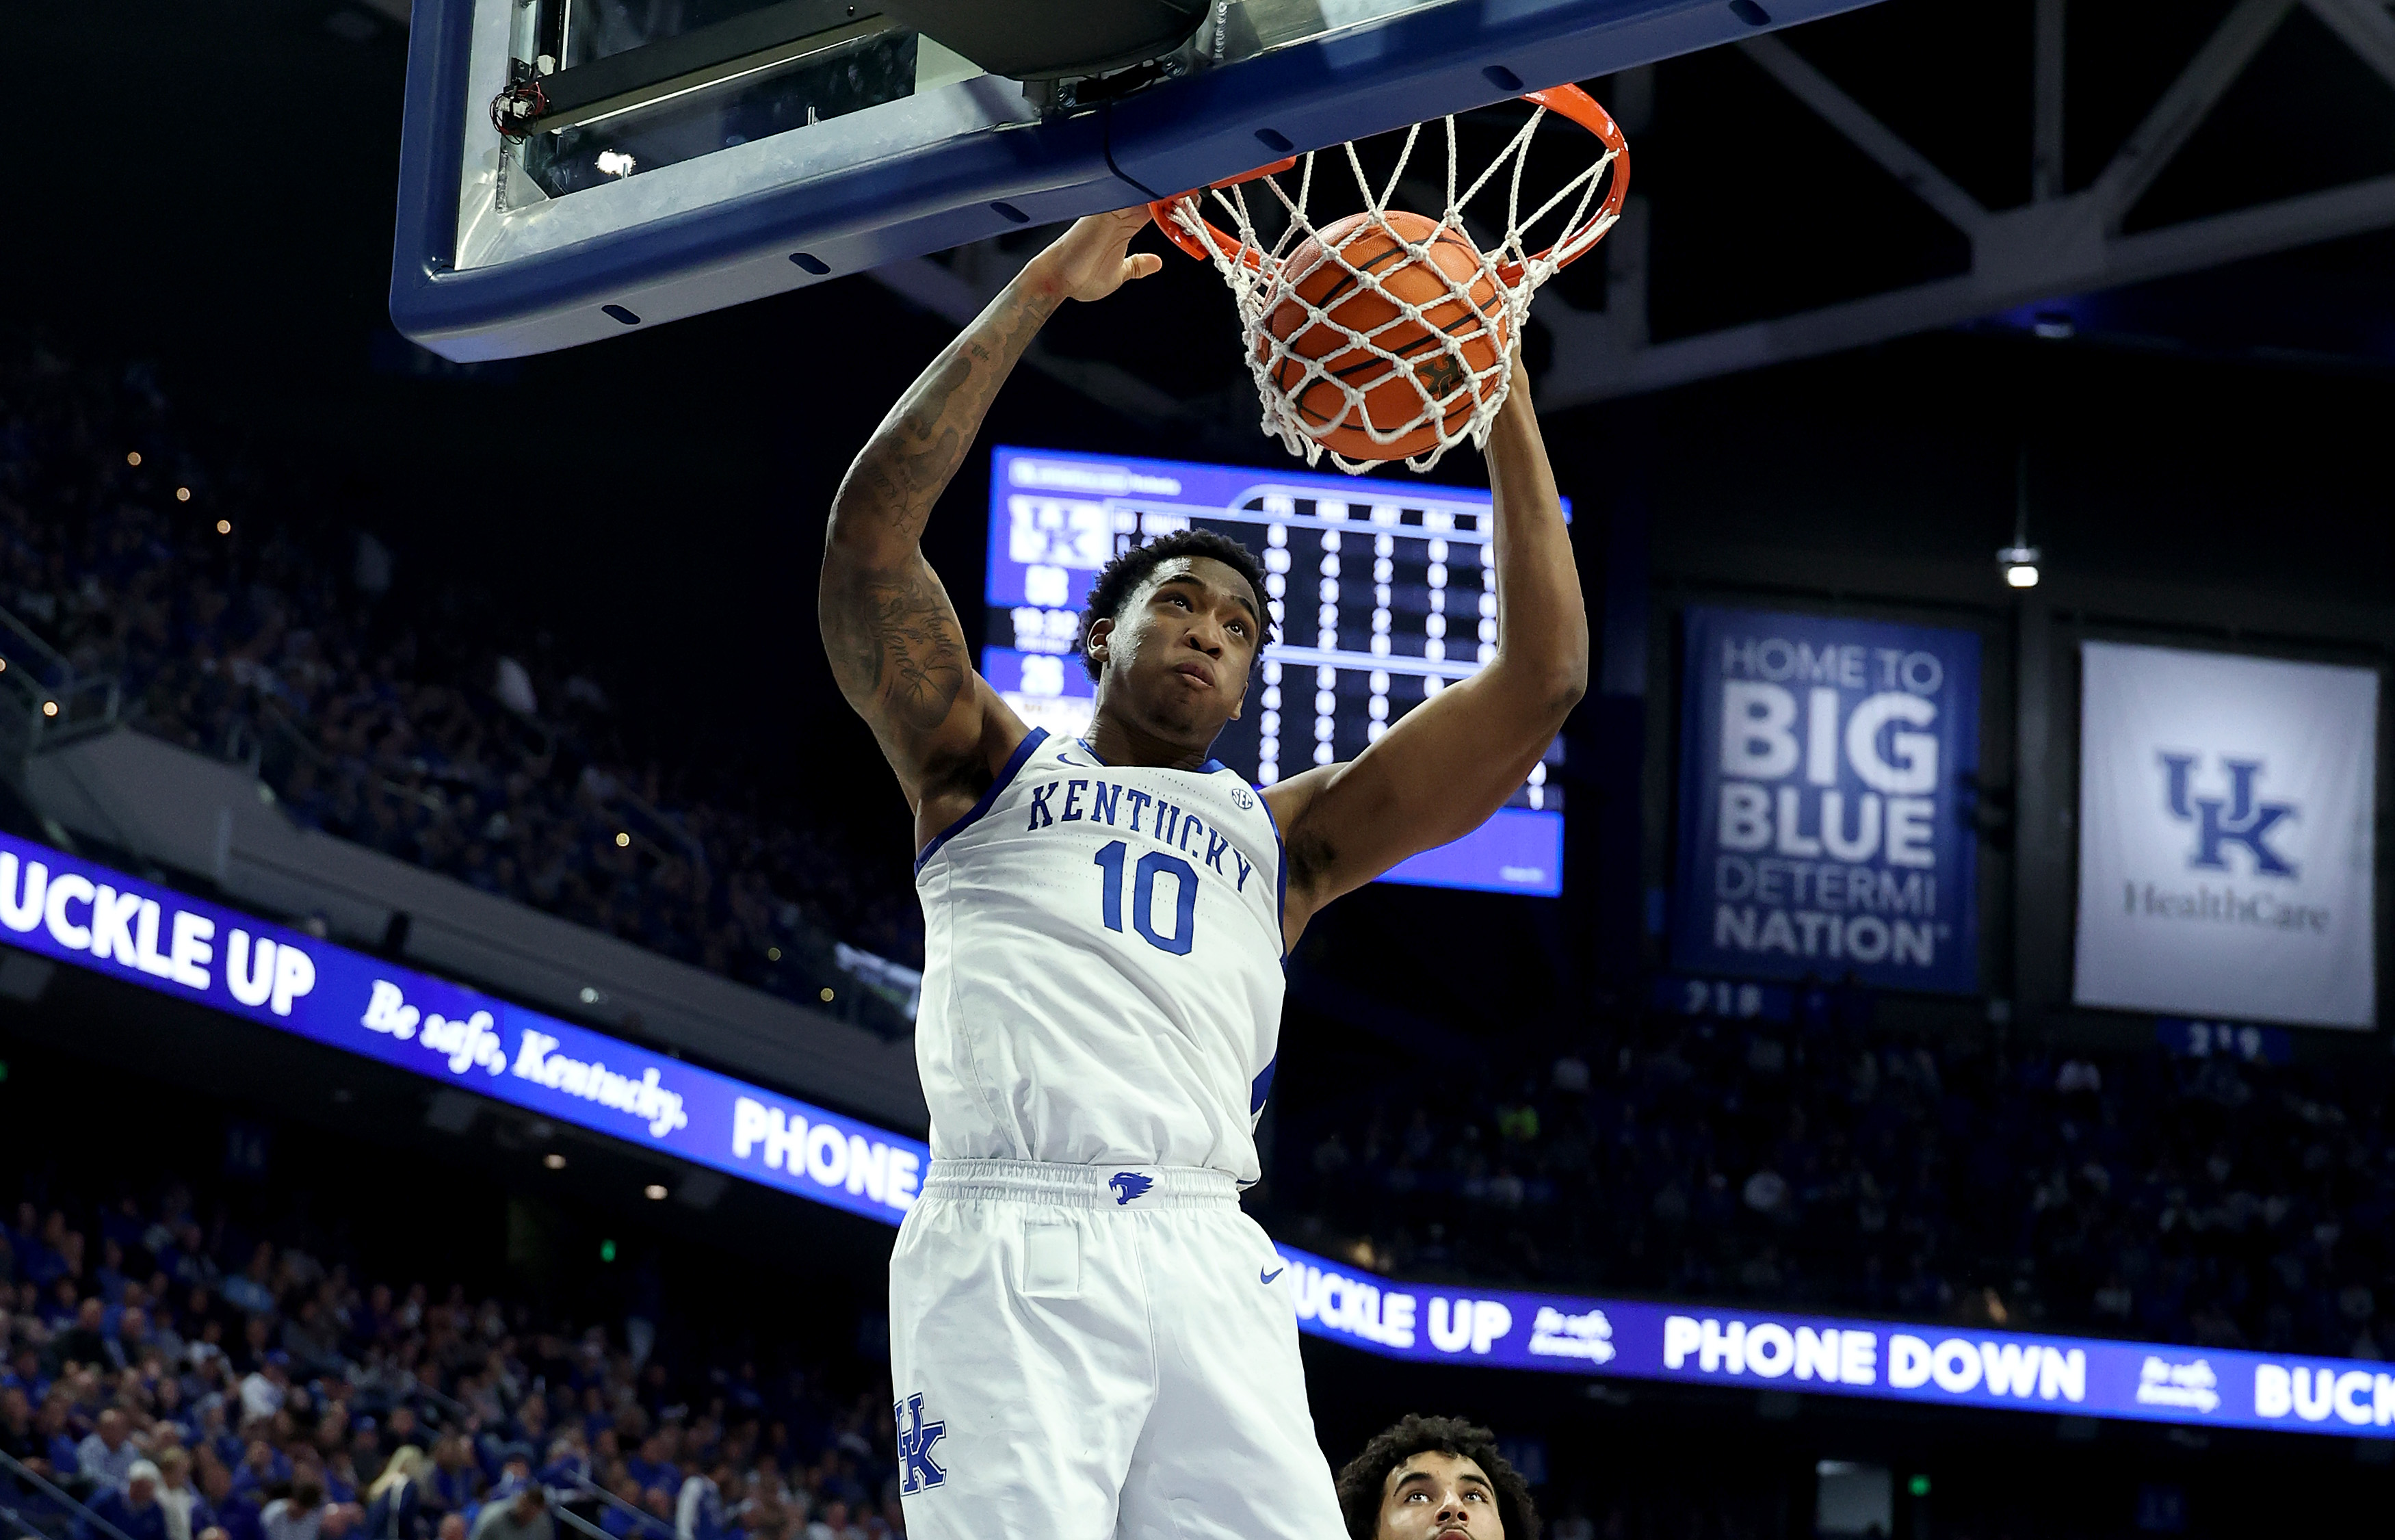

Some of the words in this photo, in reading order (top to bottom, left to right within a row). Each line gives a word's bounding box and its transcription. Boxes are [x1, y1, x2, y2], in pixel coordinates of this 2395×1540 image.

[1721, 637, 1866, 688] HOME
[1875, 648, 1944, 696] TO
[1721, 679, 1939, 796] BIG
[1027, 779, 1252, 893] KENTUCKY
[1232, 788, 1253, 809] SEC
[1718, 781, 1937, 869] BLUE
[2156, 749, 2300, 881] UK
[1094, 839, 1199, 956] 10
[1715, 854, 1937, 917] DETERMI
[2123, 878, 2329, 932] HealthCare
[226, 928, 316, 1016] UP
[361, 979, 421, 1040] Be
[732, 1096, 920, 1212] PHONE
[1278, 1255, 1416, 1349] UCKLE
[1428, 1297, 1513, 1355] UP
[1663, 1315, 1877, 1385] PHONE
[1887, 1333, 2086, 1402] DOWN
[893, 1392, 947, 1497] UK
